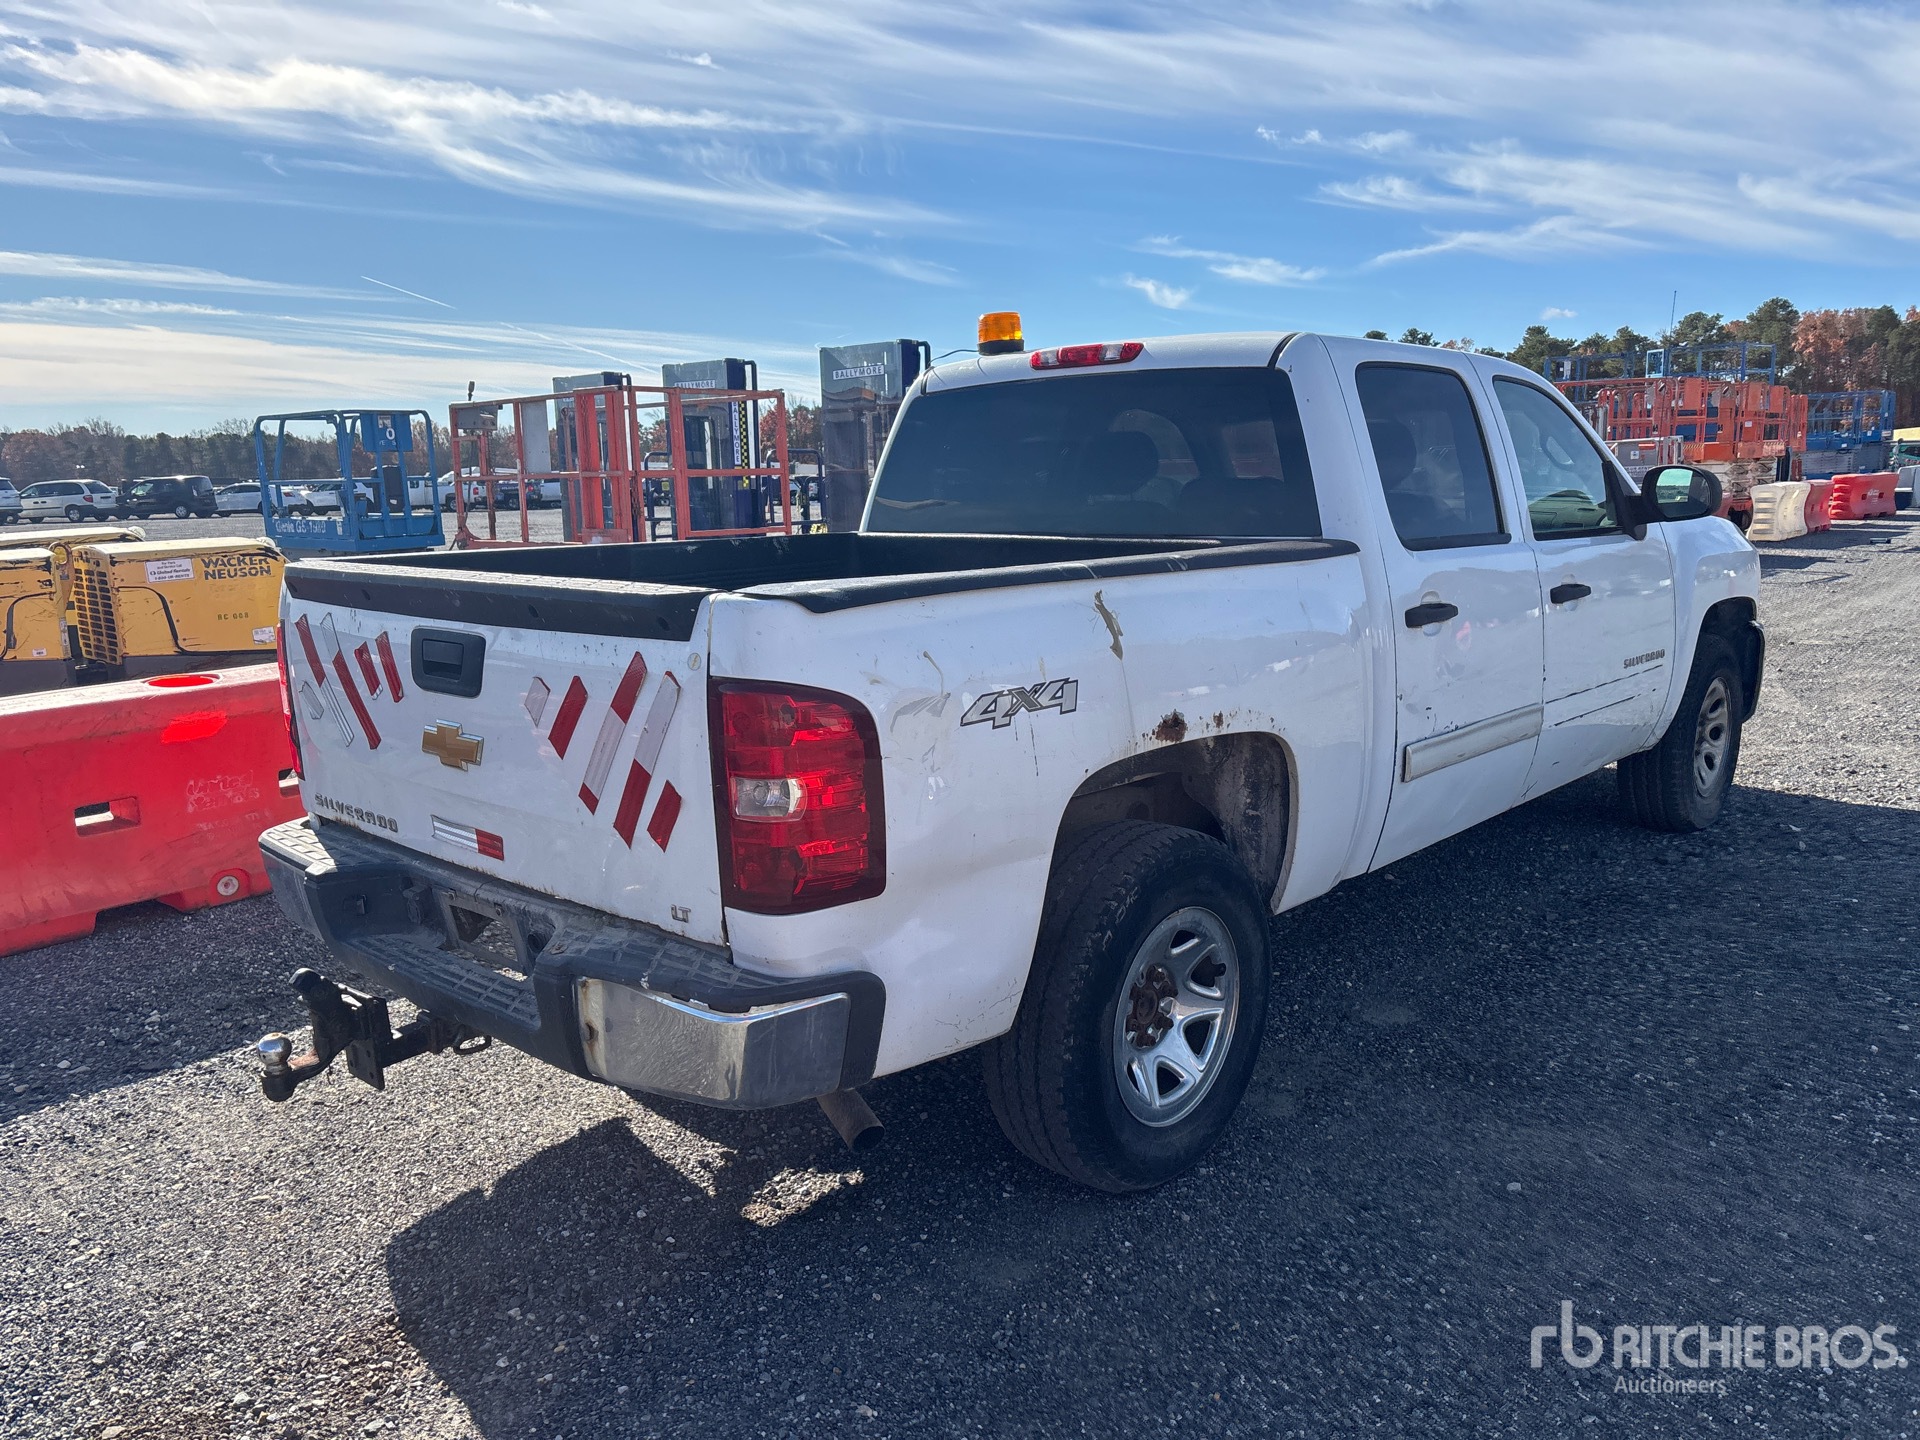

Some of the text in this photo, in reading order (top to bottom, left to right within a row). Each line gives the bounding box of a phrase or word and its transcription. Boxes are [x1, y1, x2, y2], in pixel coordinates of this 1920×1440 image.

[834, 366, 883, 379] BALLYMORE
[201, 556, 271, 569] WACKER
[204, 566, 271, 580] NEUSON
[1623, 648, 1666, 669] SILVERADO
[315, 792, 399, 833] SILVERADO
[671, 904, 691, 923] LT
